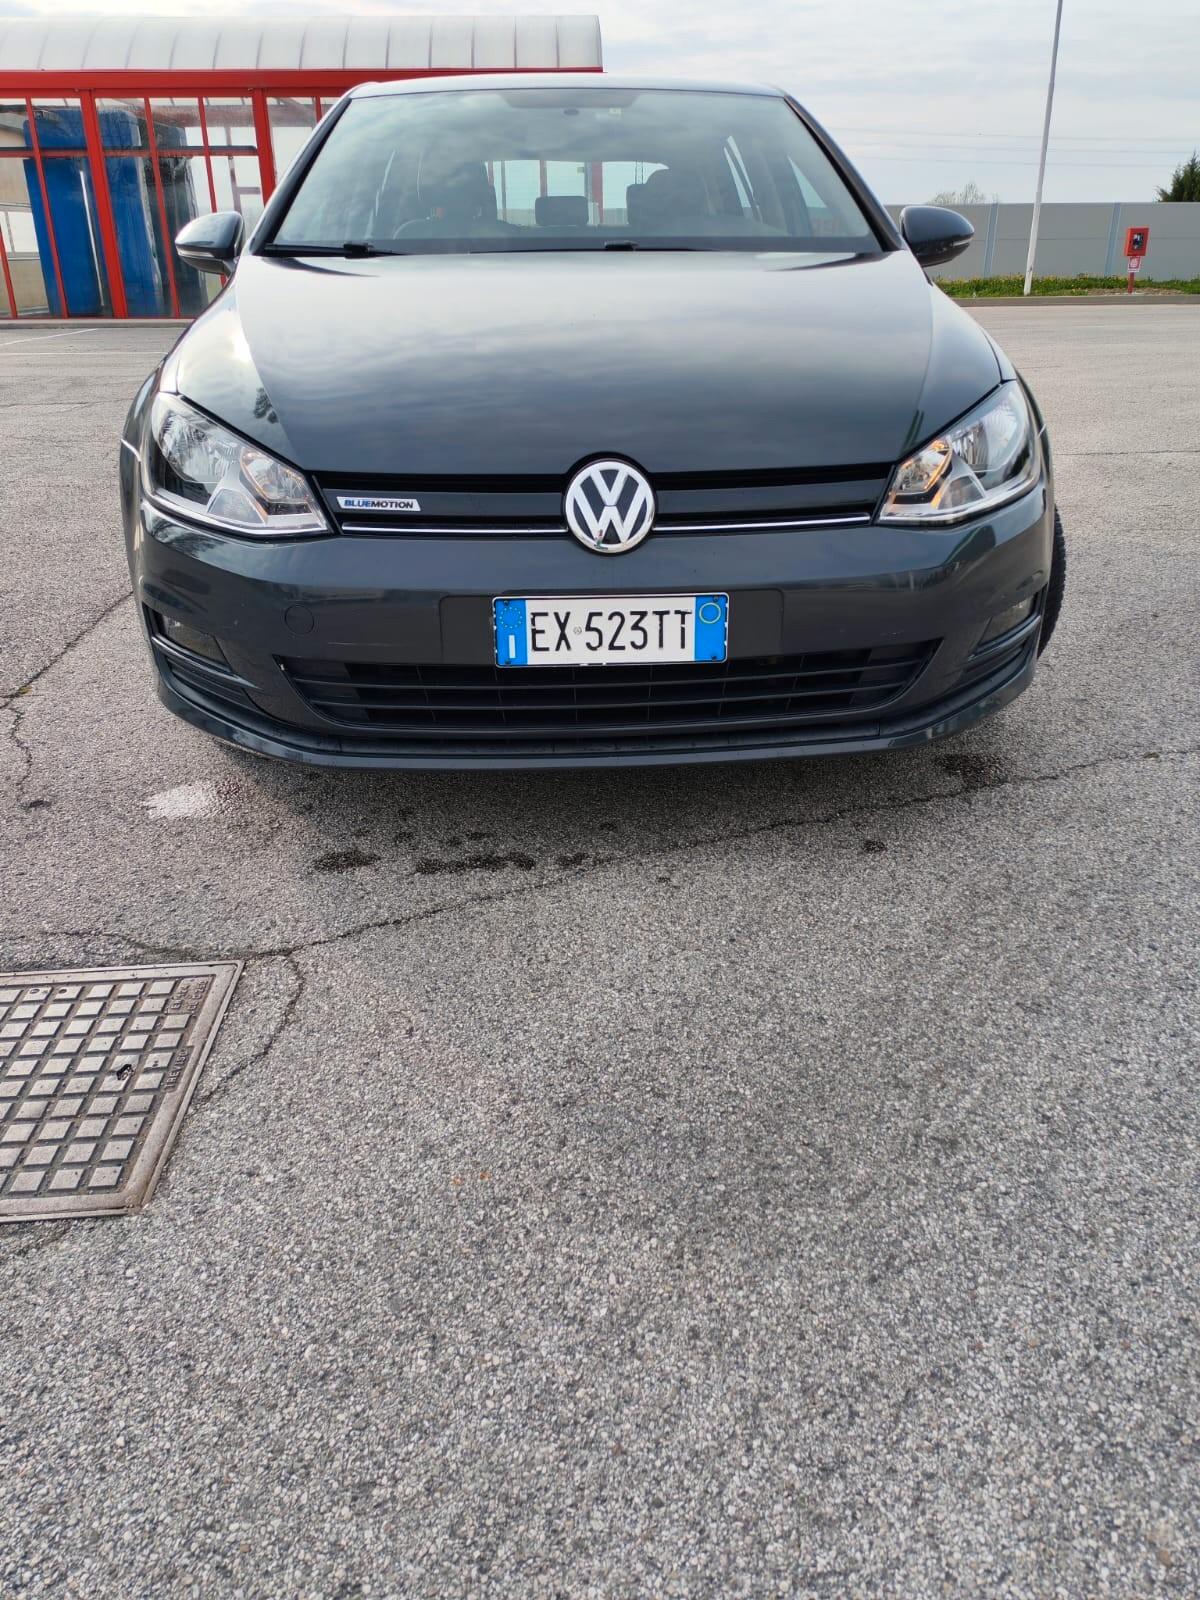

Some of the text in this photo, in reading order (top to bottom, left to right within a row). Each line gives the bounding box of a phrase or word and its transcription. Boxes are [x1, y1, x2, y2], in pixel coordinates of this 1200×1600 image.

[344, 499, 414, 509] BLUEMOTION
[569, 461, 653, 544] VW
[508, 634, 516, 658] I
[530, 610, 693, 651] EX 523TT
